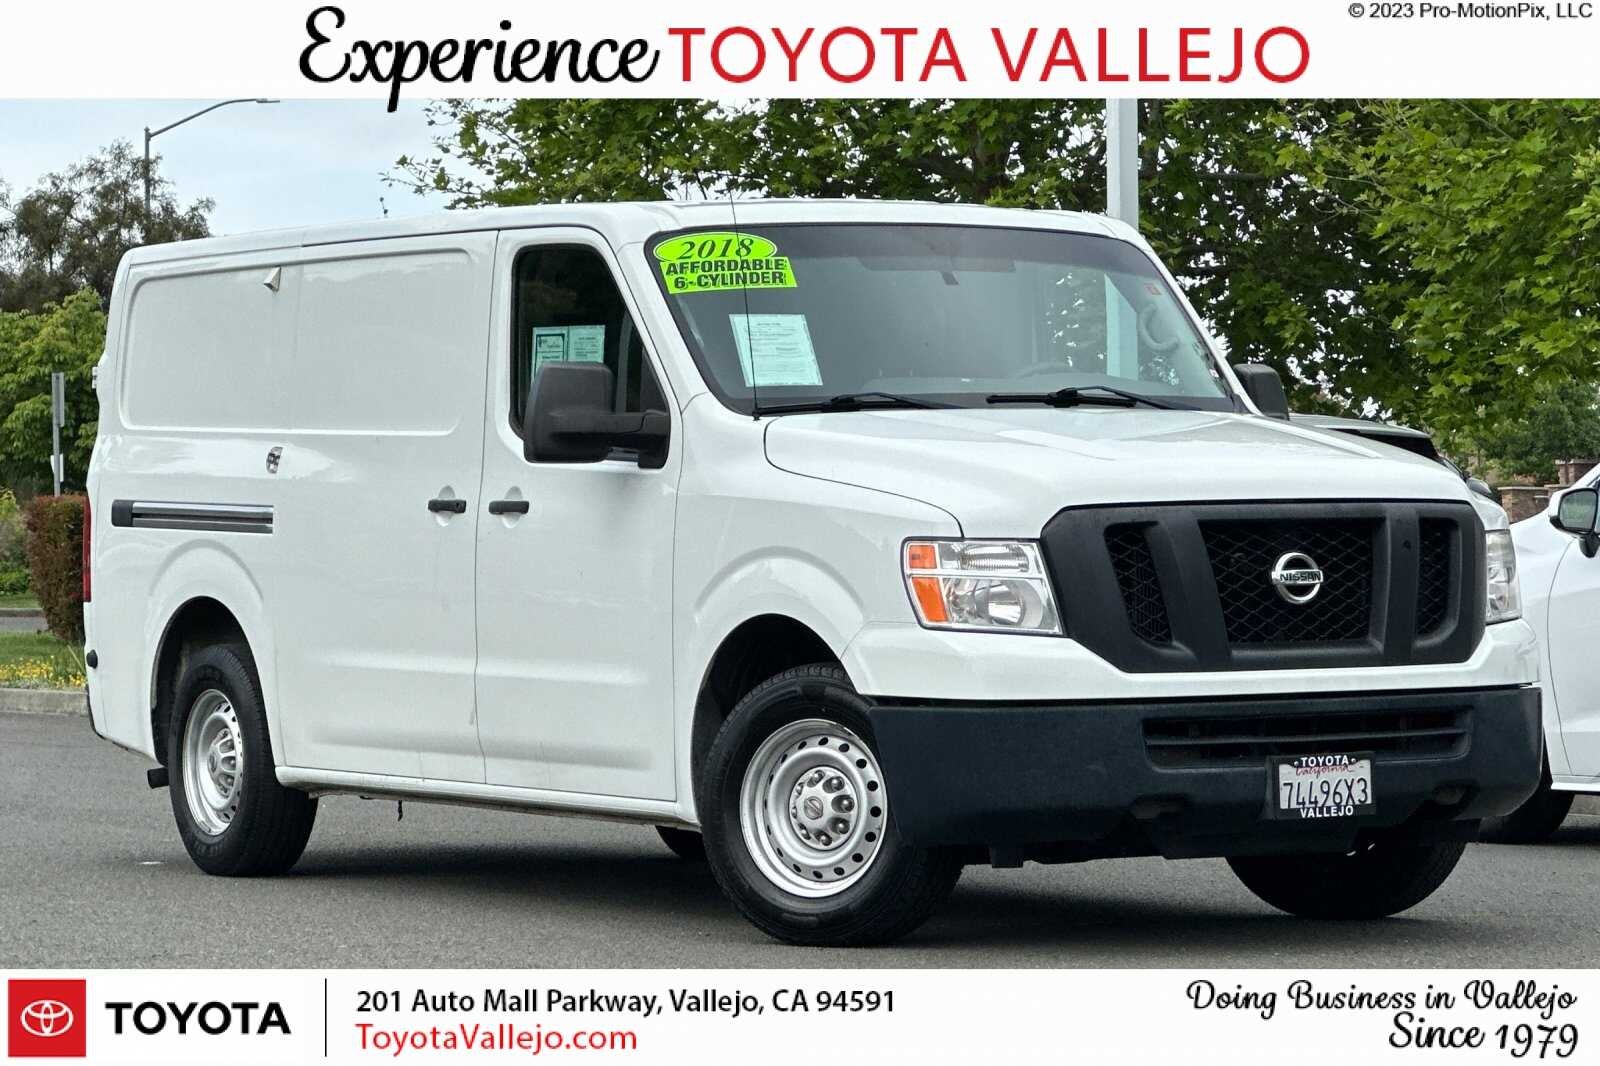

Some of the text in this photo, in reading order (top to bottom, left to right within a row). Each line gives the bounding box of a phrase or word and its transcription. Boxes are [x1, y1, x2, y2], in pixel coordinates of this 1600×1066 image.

[677, 237, 754, 260] 2018
[665, 258, 786, 276] AFFORDABLE
[673, 271, 785, 290] 6-CYLINDER
[1280, 570, 1321, 582] NISSAN
[1301, 755, 1350, 767] TOYOTA
[1283, 777, 1368, 808] 74496X3
[1300, 805, 1354, 818] VALLEJO
